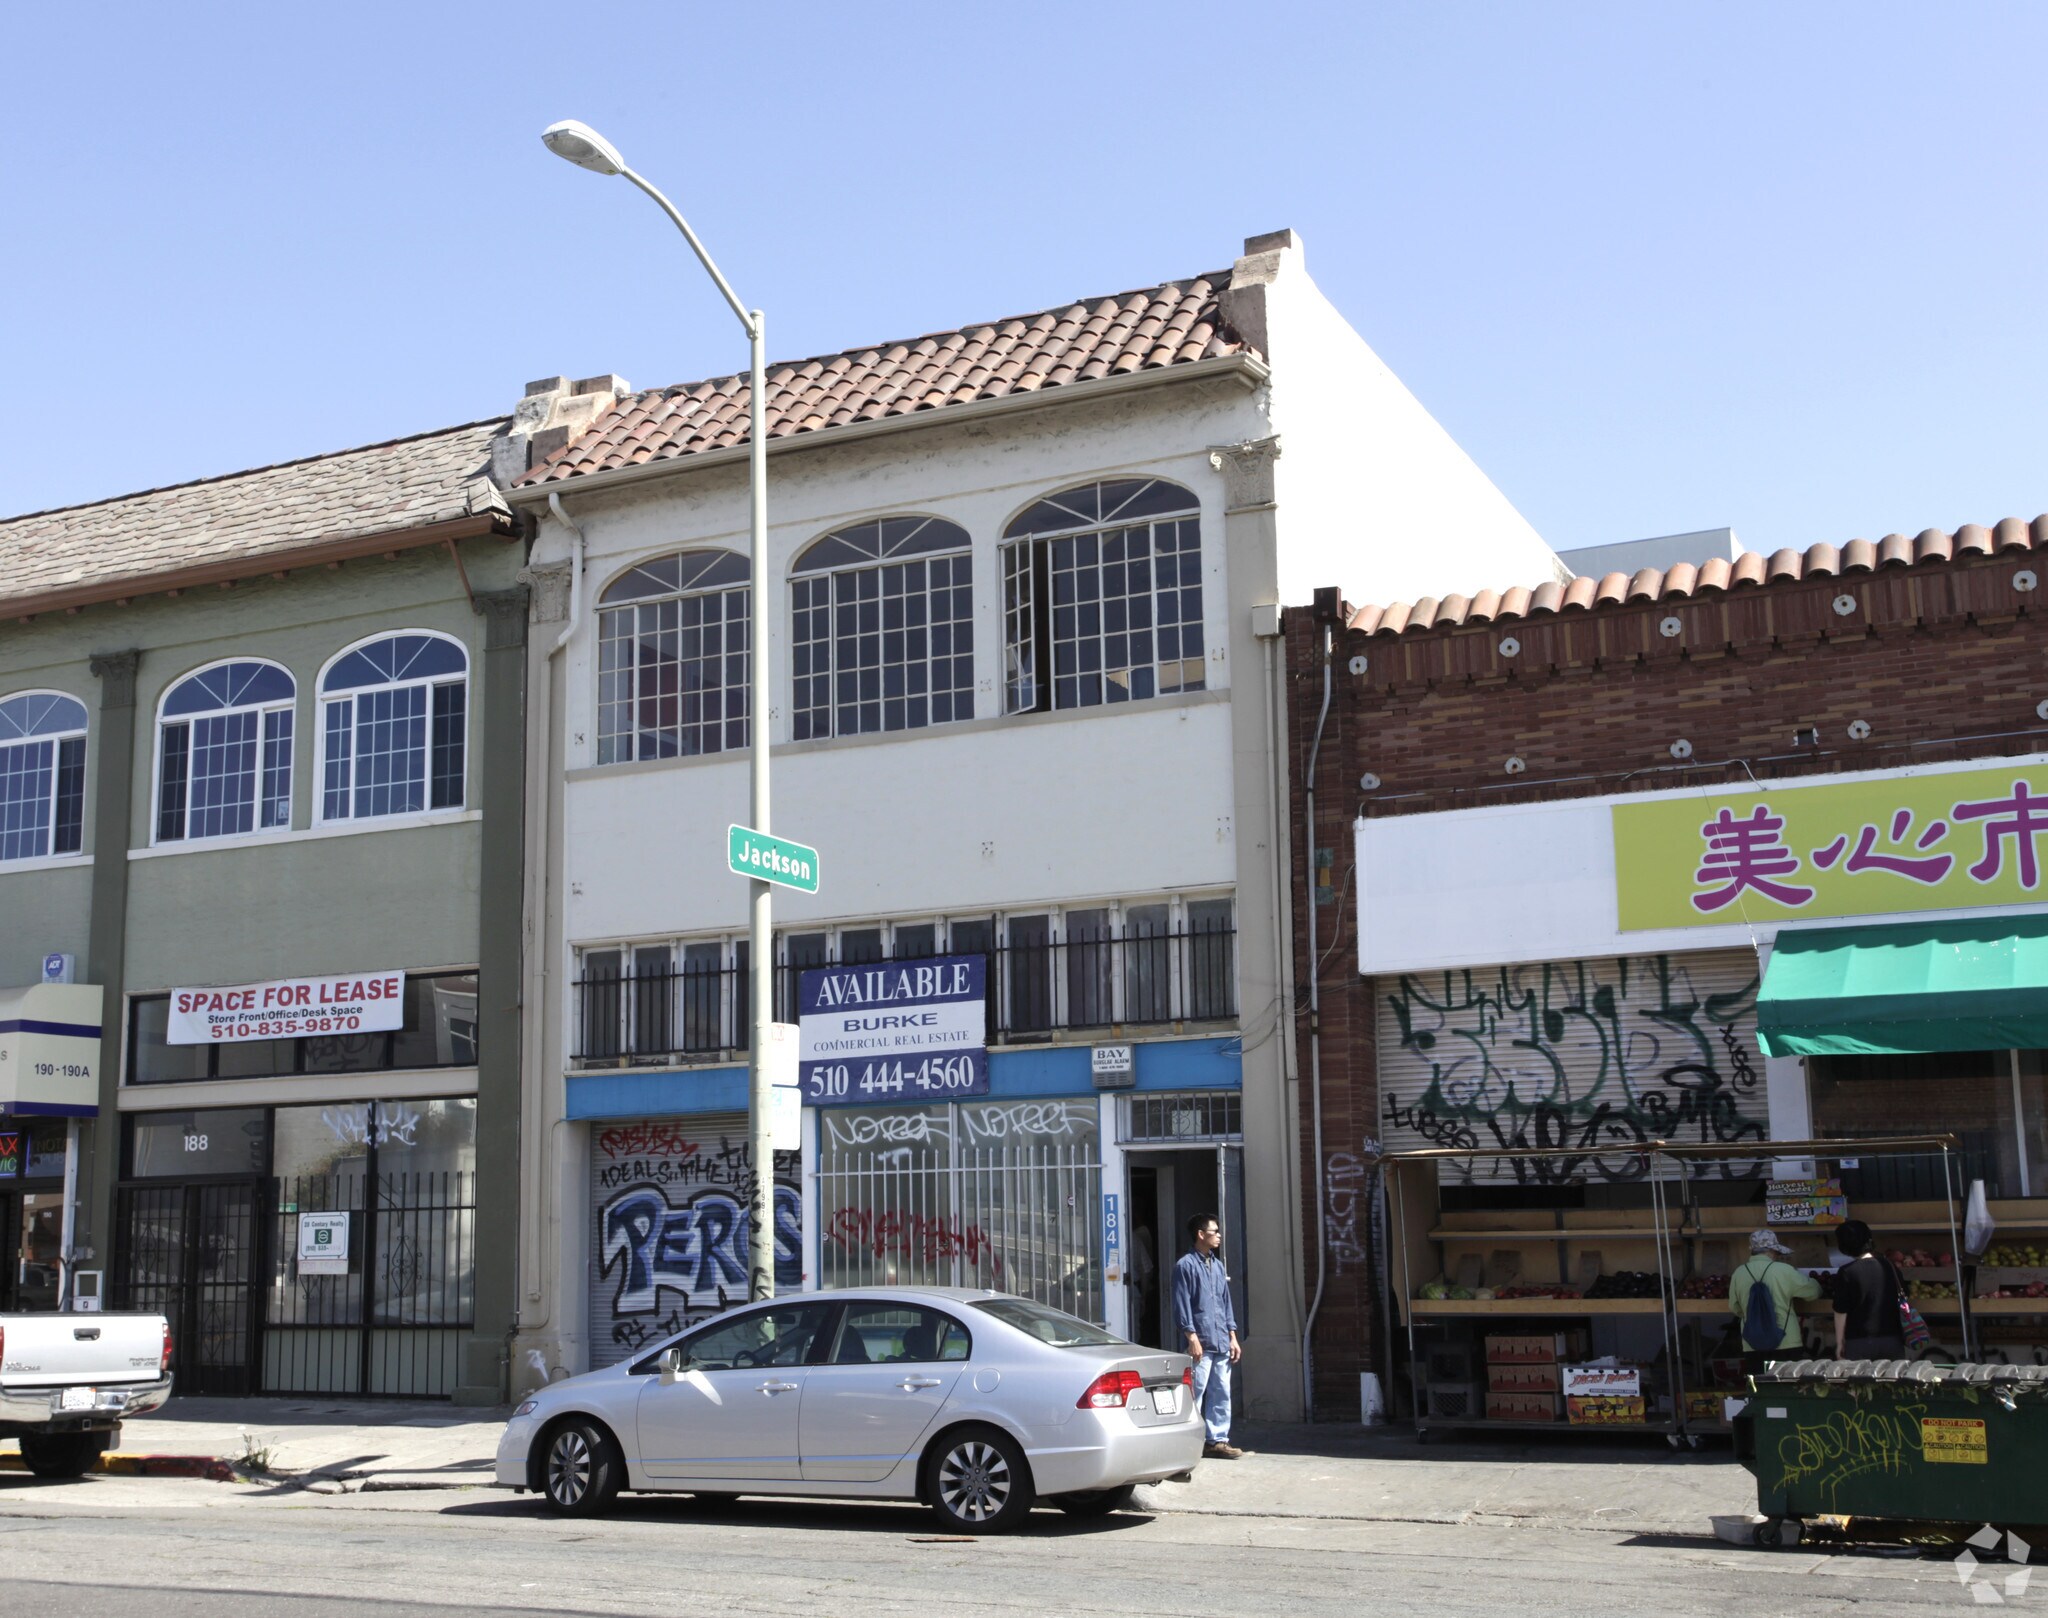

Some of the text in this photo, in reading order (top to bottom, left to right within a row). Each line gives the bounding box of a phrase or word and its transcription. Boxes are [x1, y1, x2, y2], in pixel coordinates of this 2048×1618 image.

[1691, 780, 2048, 912] 美心市
[738, 840, 810, 880] Jackson
[178, 978, 399, 1013] SPACE FOR LEASE
[816, 963, 971, 1006] AVAILABLE
[208, 1006, 363, 1024] Store Front/Office/Desk Space
[844, 1012, 938, 1032] BURKE
[211, 1016, 360, 1038] 510-835-9870
[813, 1030, 970, 1052] COMMERCIAL REAL ESTATE
[1097, 1049, 1126, 1059] BAY
[810, 1055, 974, 1097] 510 444-4560
[184, 1135, 208, 1151] 188
[1767, 1181, 1812, 1195] Harvest Sweet
[1767, 1201, 1811, 1214] Harvest
[1774, 1209, 1811, 1220] Sweet
[1106, 1196, 1117, 1245] 184
